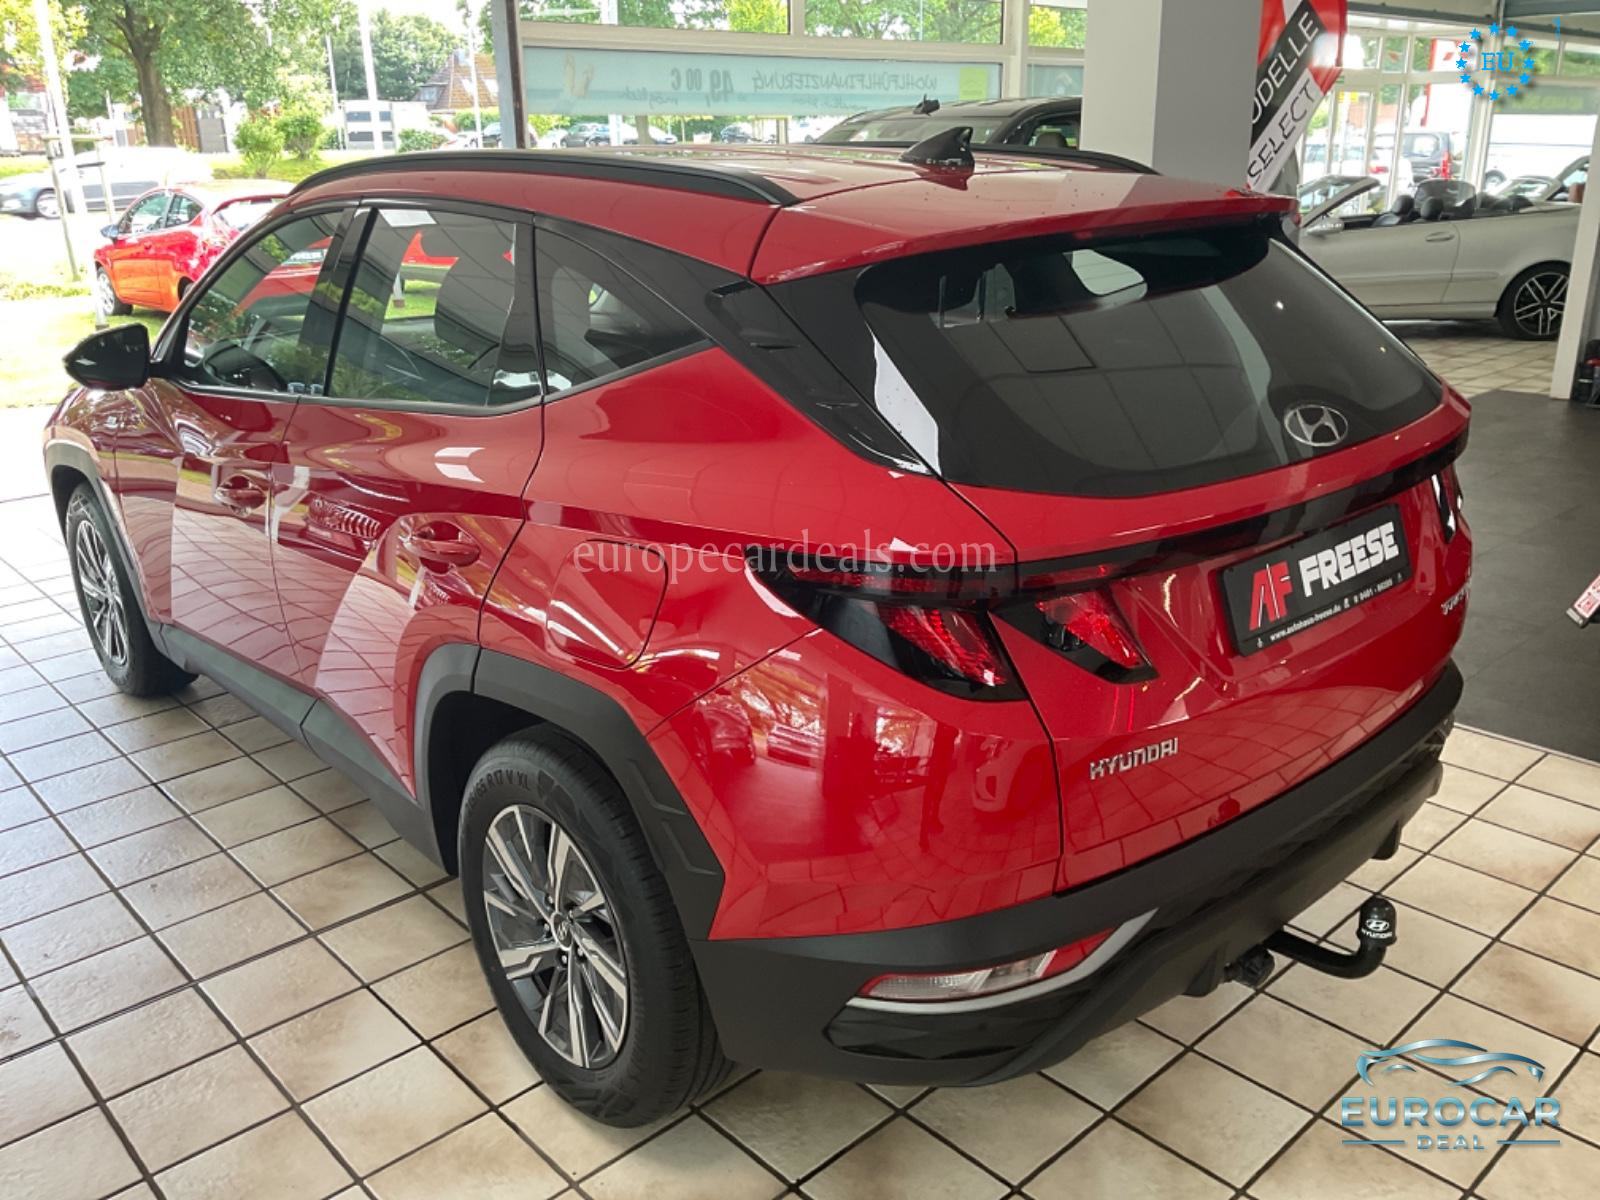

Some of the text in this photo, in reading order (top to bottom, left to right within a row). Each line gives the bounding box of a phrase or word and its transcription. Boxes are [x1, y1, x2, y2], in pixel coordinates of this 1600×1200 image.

[1247, 79, 1316, 185] SELECT
[1249, 521, 1399, 631] AF FREESE
[1089, 737, 1178, 780] HYUNDAI
